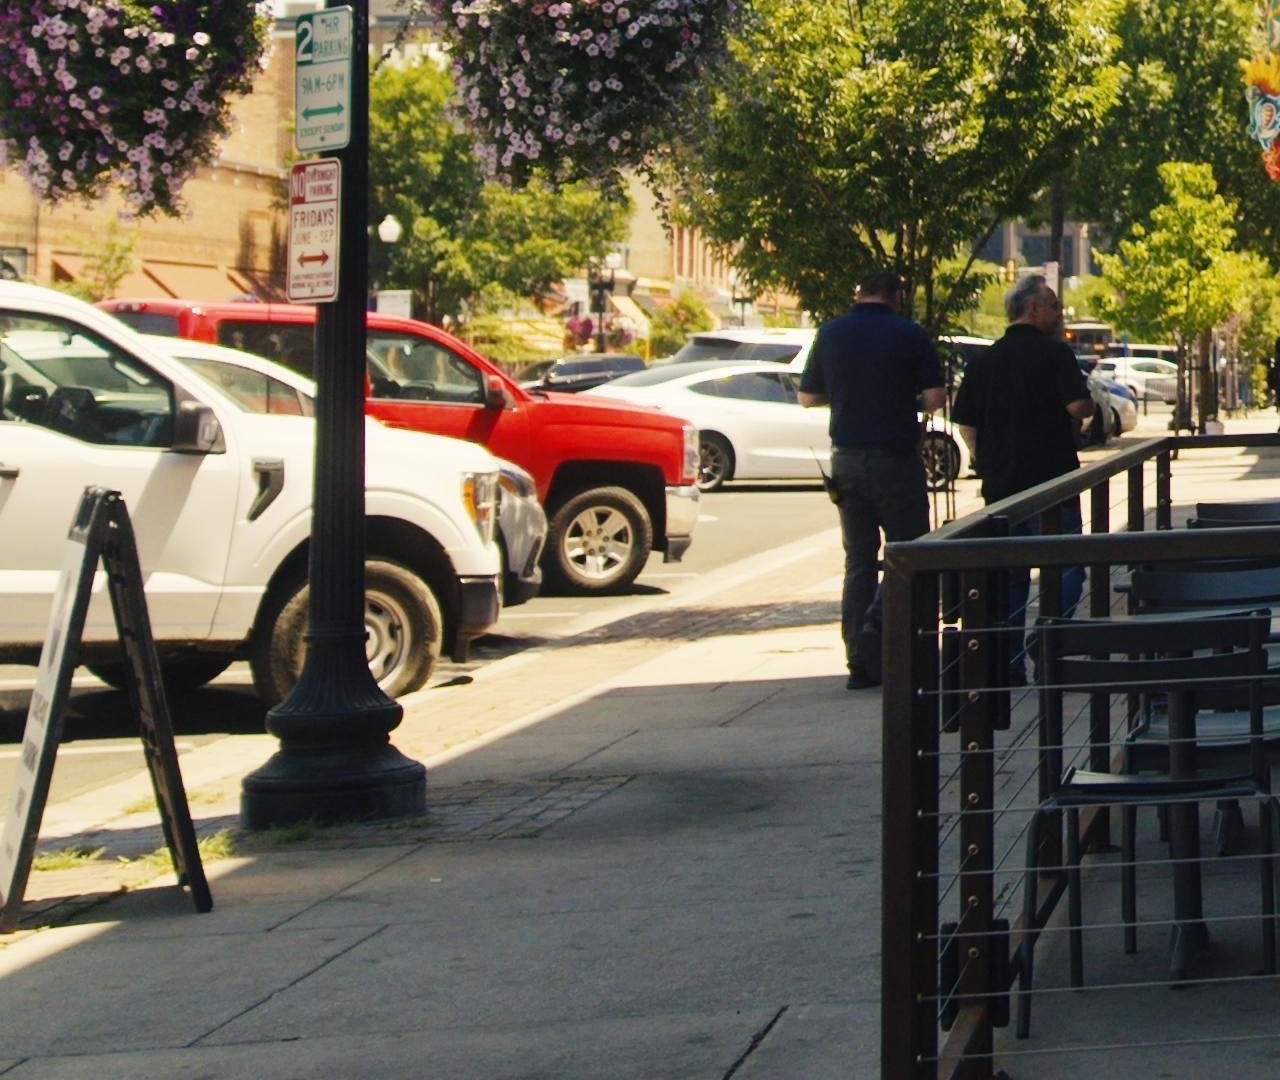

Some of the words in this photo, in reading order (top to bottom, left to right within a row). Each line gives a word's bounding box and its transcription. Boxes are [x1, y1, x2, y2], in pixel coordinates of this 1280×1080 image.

[325, 16, 339, 34] HR
[297, 20, 313, 62] 2
[312, 36, 350, 58] PARKING
[302, 72, 345, 95] 9AM-6PM
[292, 170, 305, 199] NO
[294, 207, 335, 228] FRIDAYS
[293, 231, 311, 246] JUNE
[320, 228, 335, 244] SEP
